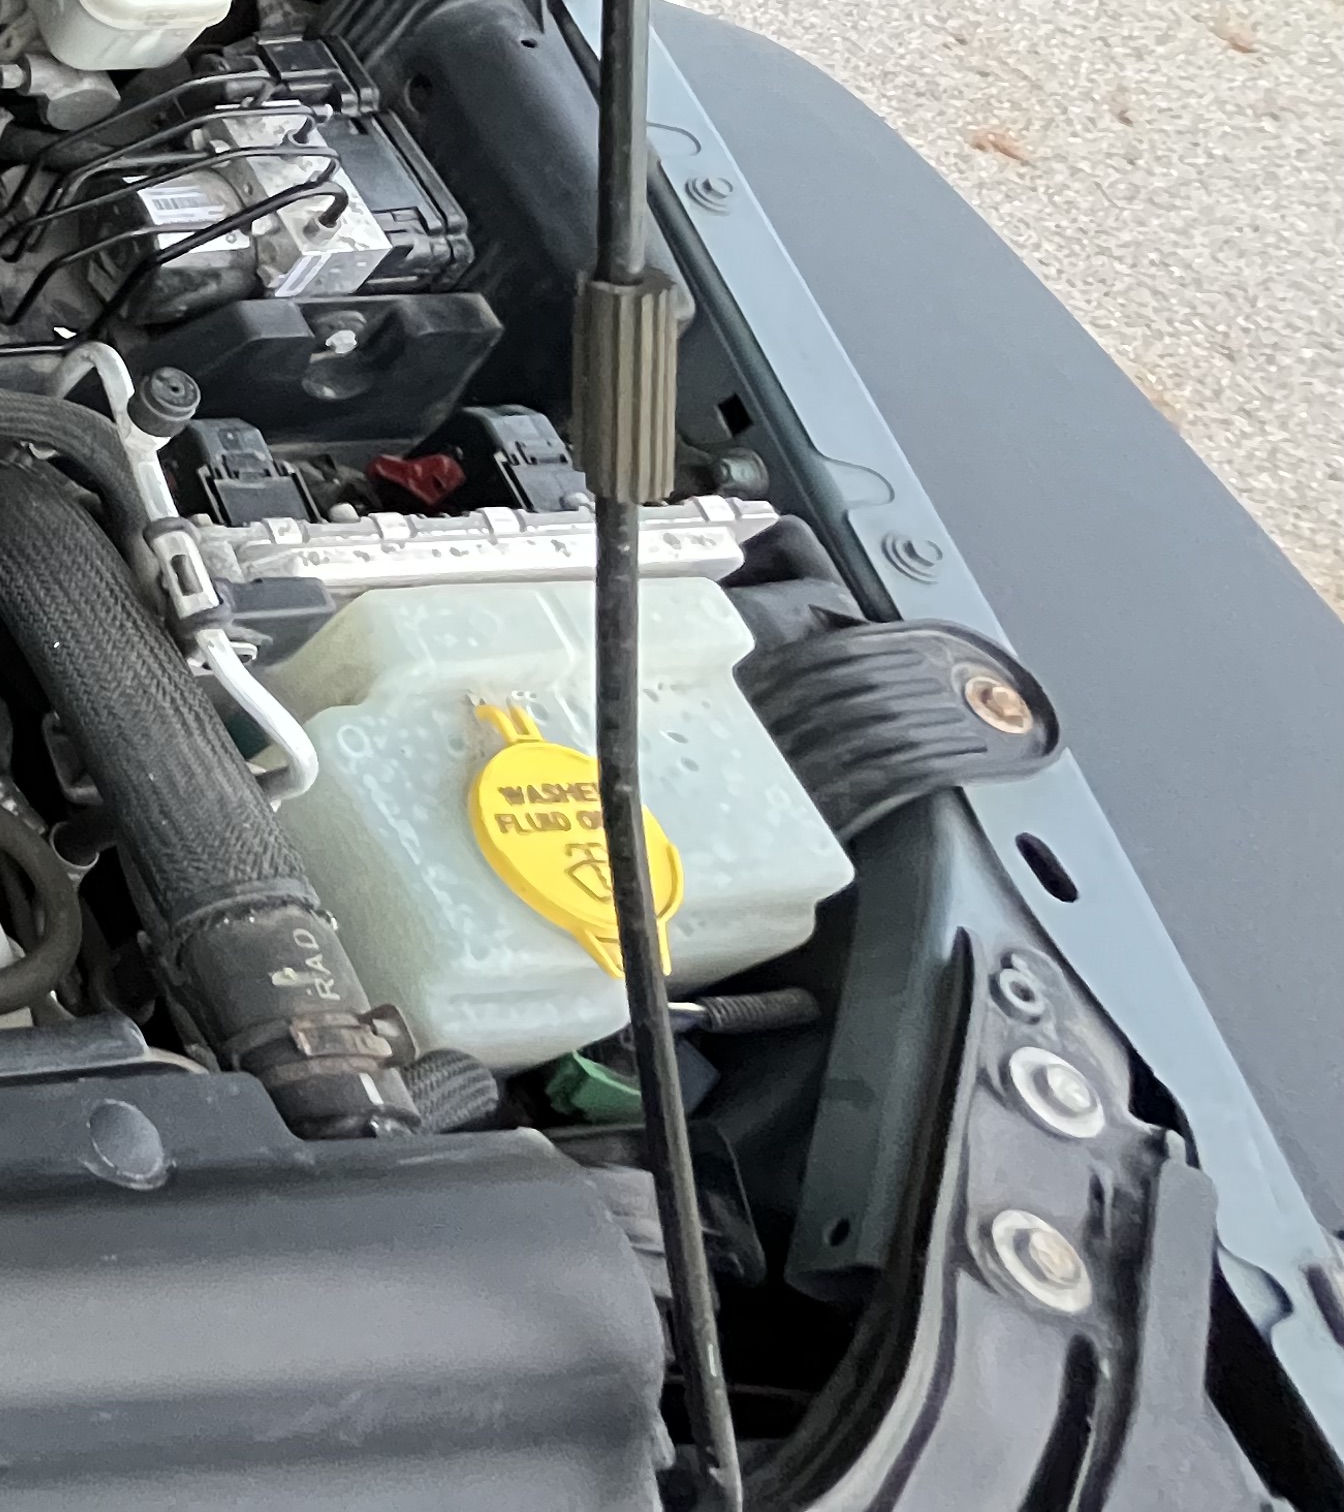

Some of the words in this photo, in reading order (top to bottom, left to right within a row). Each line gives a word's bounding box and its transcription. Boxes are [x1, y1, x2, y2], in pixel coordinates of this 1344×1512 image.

[497, 782, 599, 806] WASHE
[493, 811, 572, 835] FLUID
[295, 927, 341, 1001] RAD
